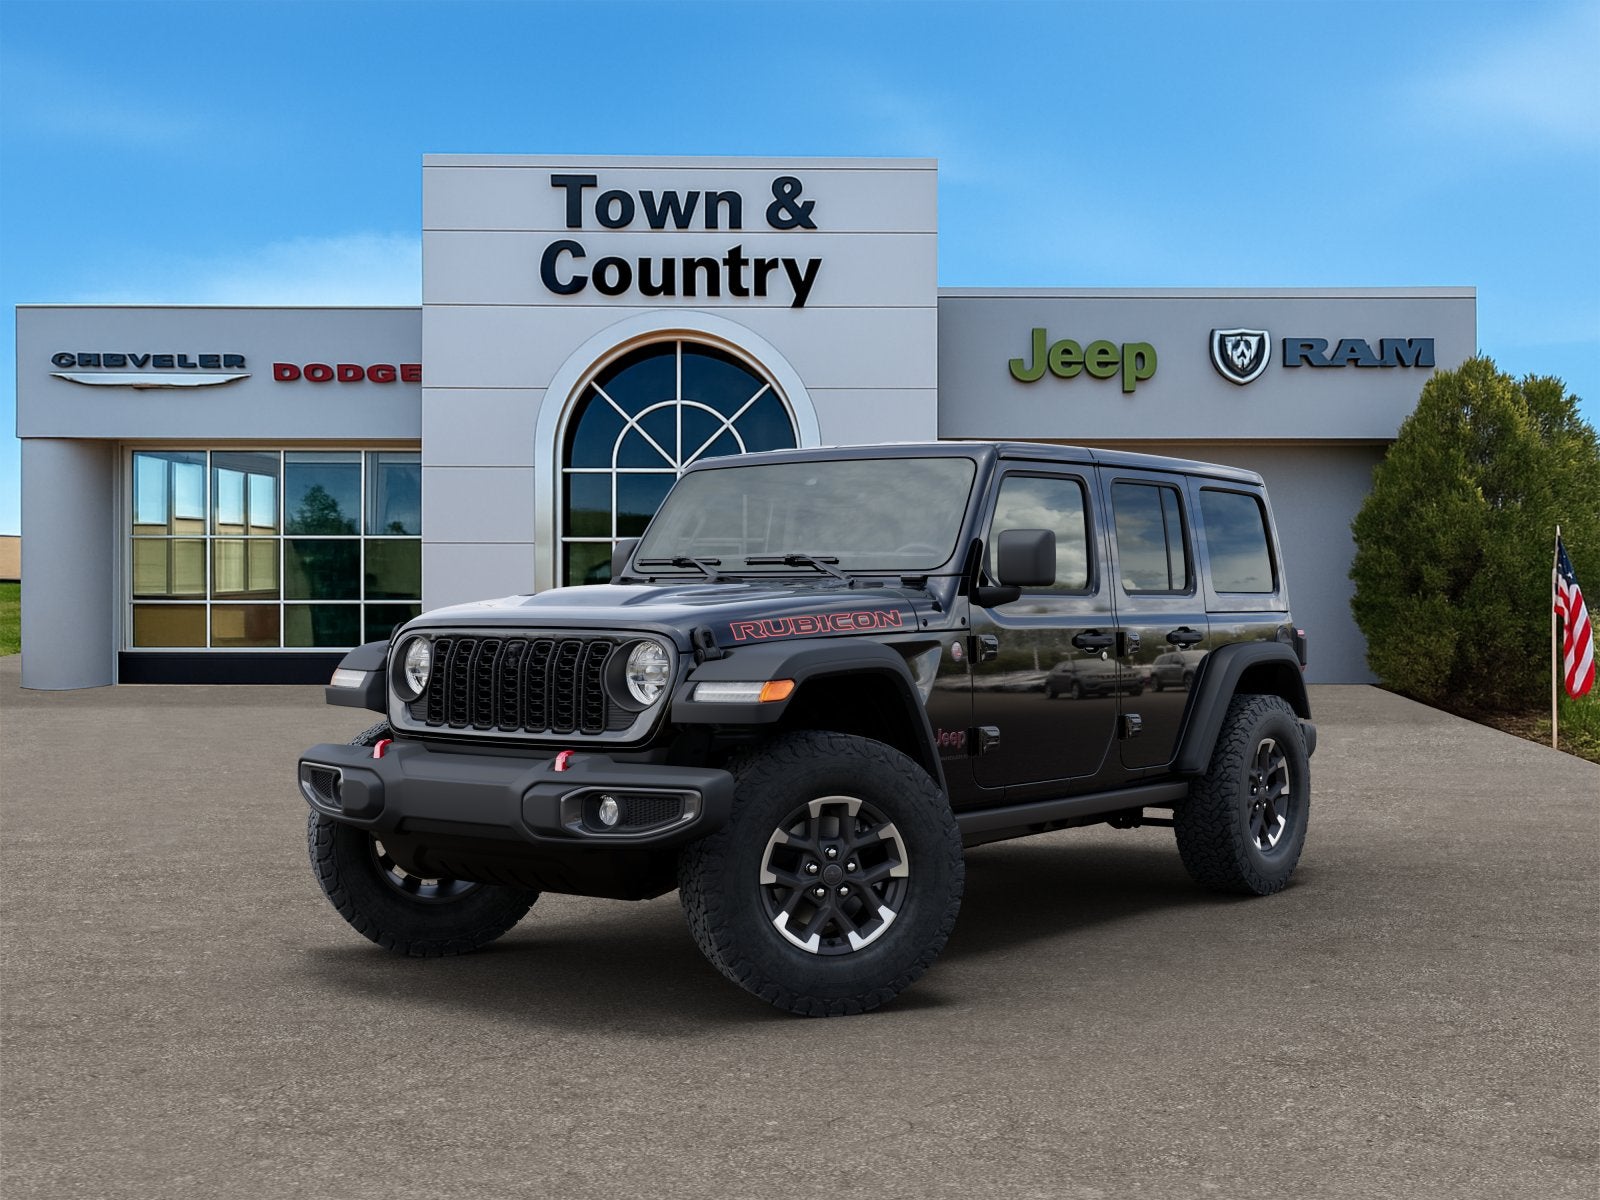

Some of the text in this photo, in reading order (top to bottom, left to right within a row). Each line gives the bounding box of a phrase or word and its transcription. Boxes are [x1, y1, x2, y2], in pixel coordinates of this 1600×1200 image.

[550, 174, 818, 230] Town &
[540, 239, 823, 308] Country
[1009, 328, 1158, 393] Jeep
[1282, 337, 1435, 368] RAM
[273, 363, 422, 383] DODGE
[730, 609, 903, 641] RUBICON
[936, 728, 966, 750] Jeep
